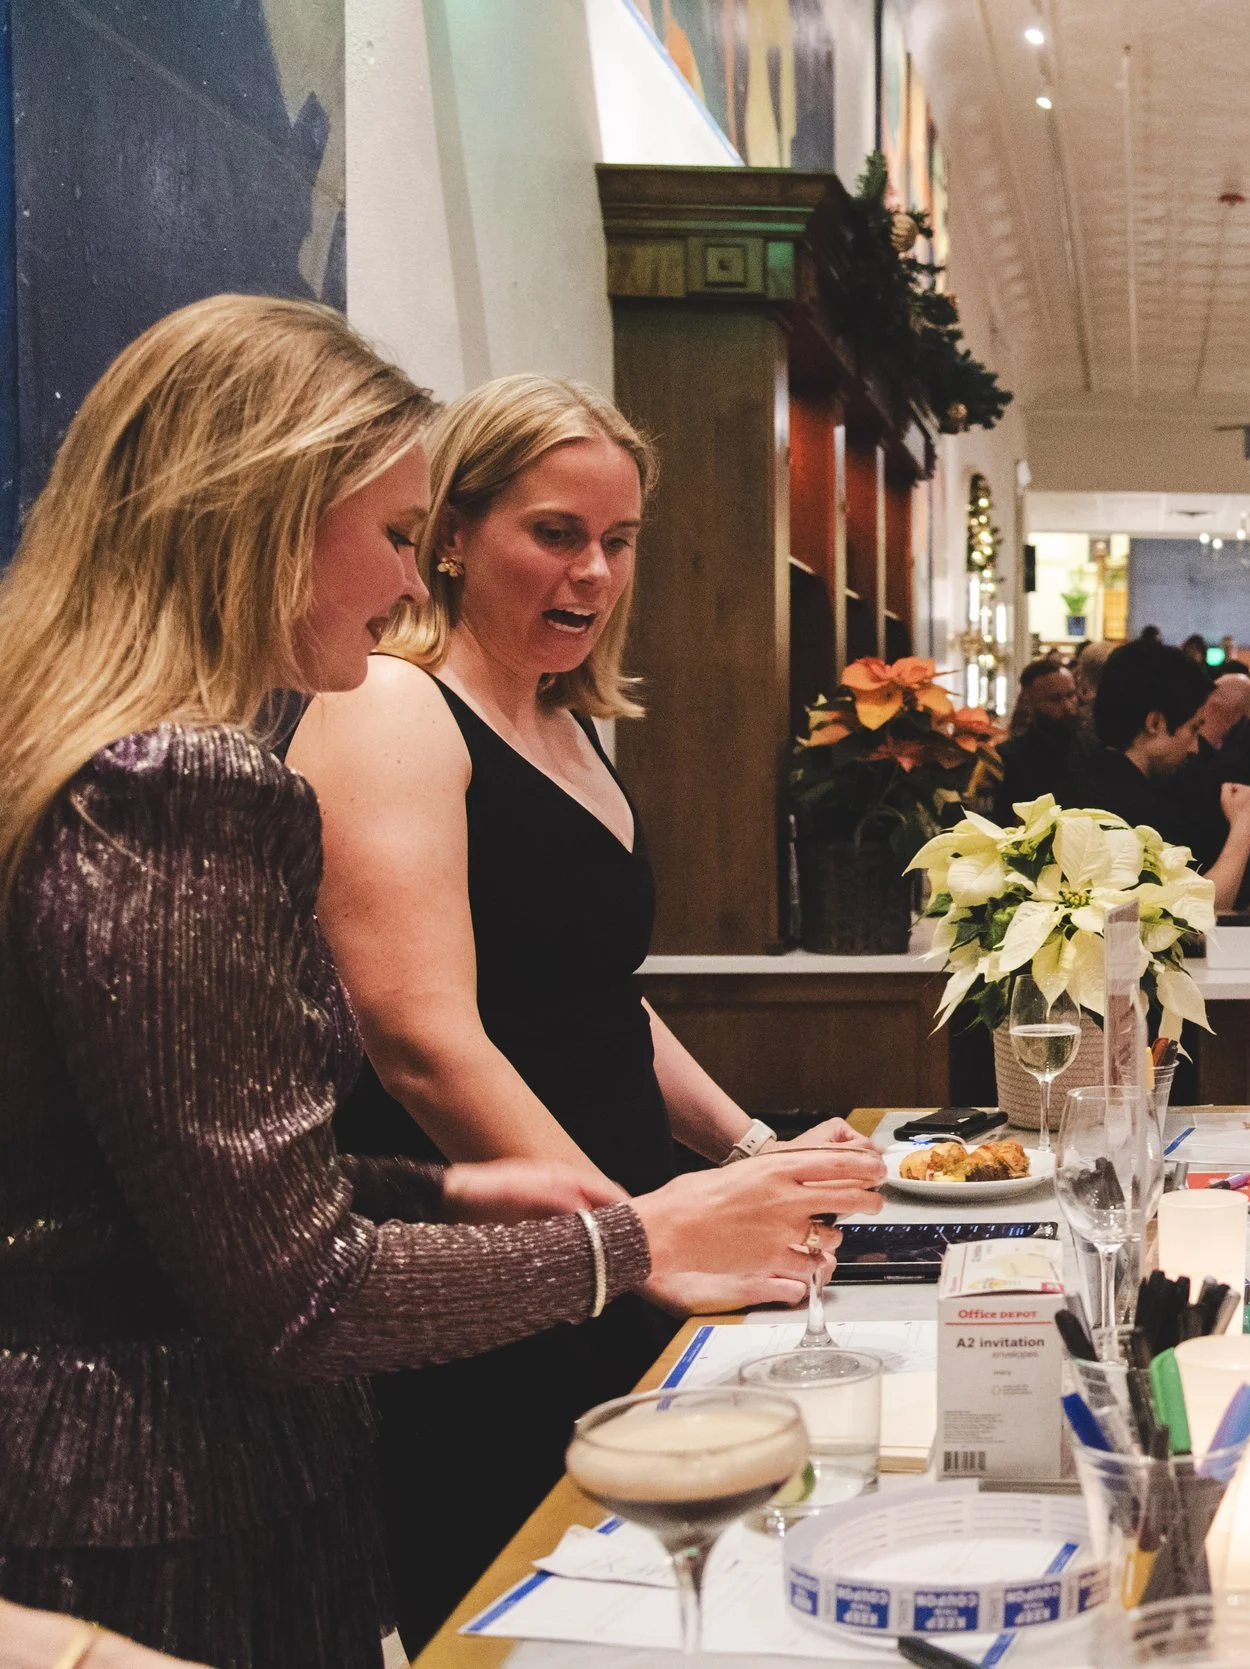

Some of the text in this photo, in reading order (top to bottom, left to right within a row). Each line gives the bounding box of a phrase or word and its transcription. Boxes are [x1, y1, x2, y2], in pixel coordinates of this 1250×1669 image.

[958, 1310, 997, 1319] Office
[957, 1336, 1045, 1348] A2 invitation
[917, 1594, 977, 1607] COUPON
[925, 1616, 966, 1629] KEEP
